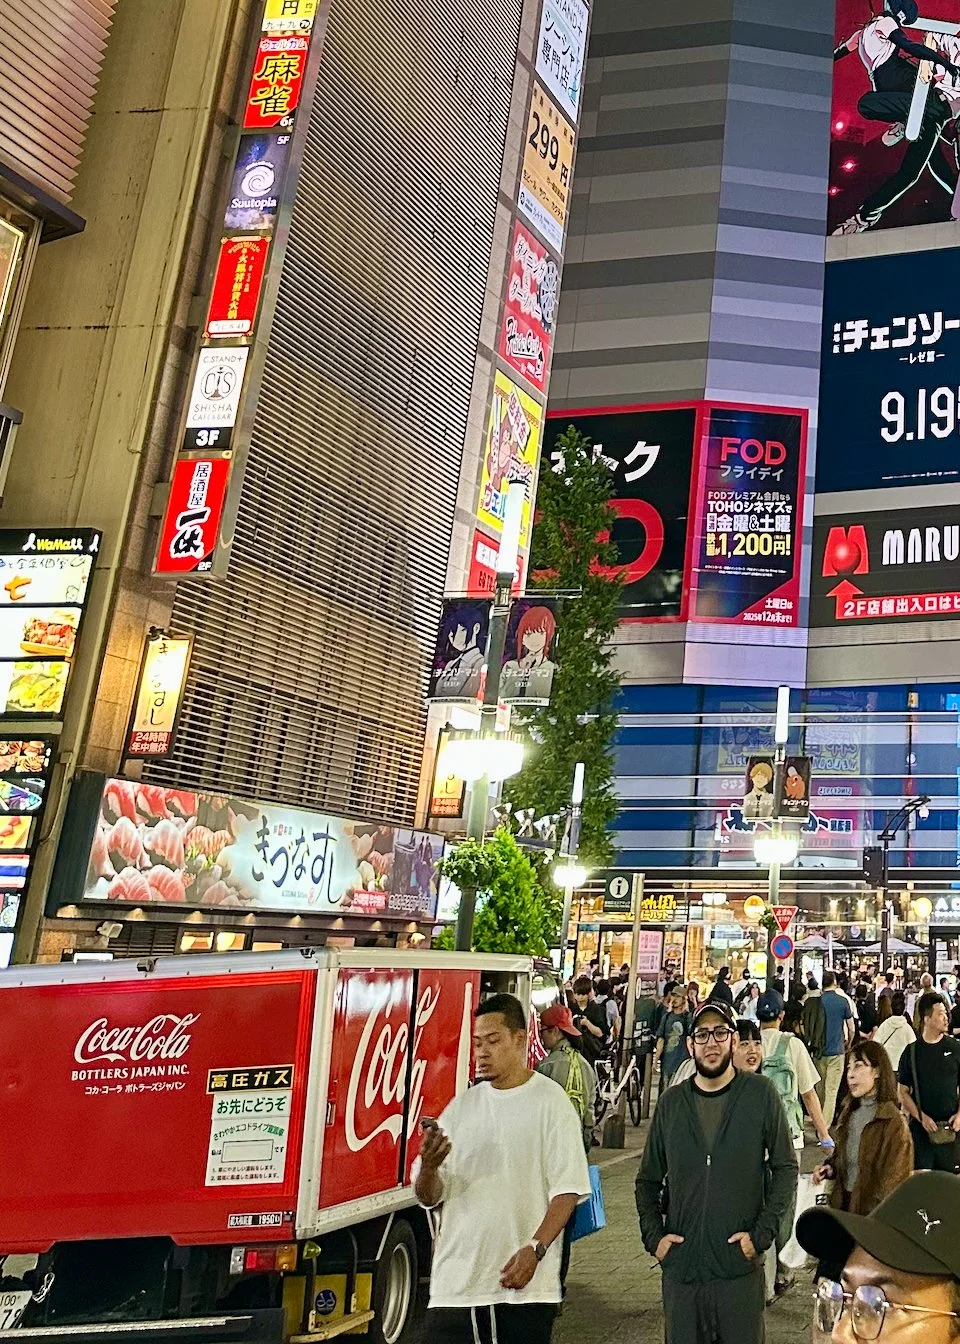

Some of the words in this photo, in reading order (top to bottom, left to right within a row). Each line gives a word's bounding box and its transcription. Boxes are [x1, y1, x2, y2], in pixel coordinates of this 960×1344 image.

[250, 52, 301, 117] 麻雀
[280, 116, 294, 128] 6F
[277, 135, 290, 145] 5F
[528, 112, 560, 170] 299
[231, 196, 277, 211] Suutopia
[880, 386, 956, 444] 9.19
[196, 429, 220, 448] 3F
[720, 437, 788, 467] FOD
[720, 464, 785, 482] フライデイ
[190, 463, 211, 506] 居酒屋
[707, 490, 791, 503] FODプレミアム会員なら
[707, 500, 793, 514] TOHOシネマズで
[717, 513, 792, 534] 金曜&土曜
[74, 1013, 201, 1064] Coca-Cola
[71, 1067, 128, 1081] BOTTLERS
[130, 1065, 165, 1079] JAPAN
[167, 1064, 190, 1076] INC.
[210, 1069, 290, 1089] 高圧ガス
[216, 1095, 287, 1115] お先にどうぞ
